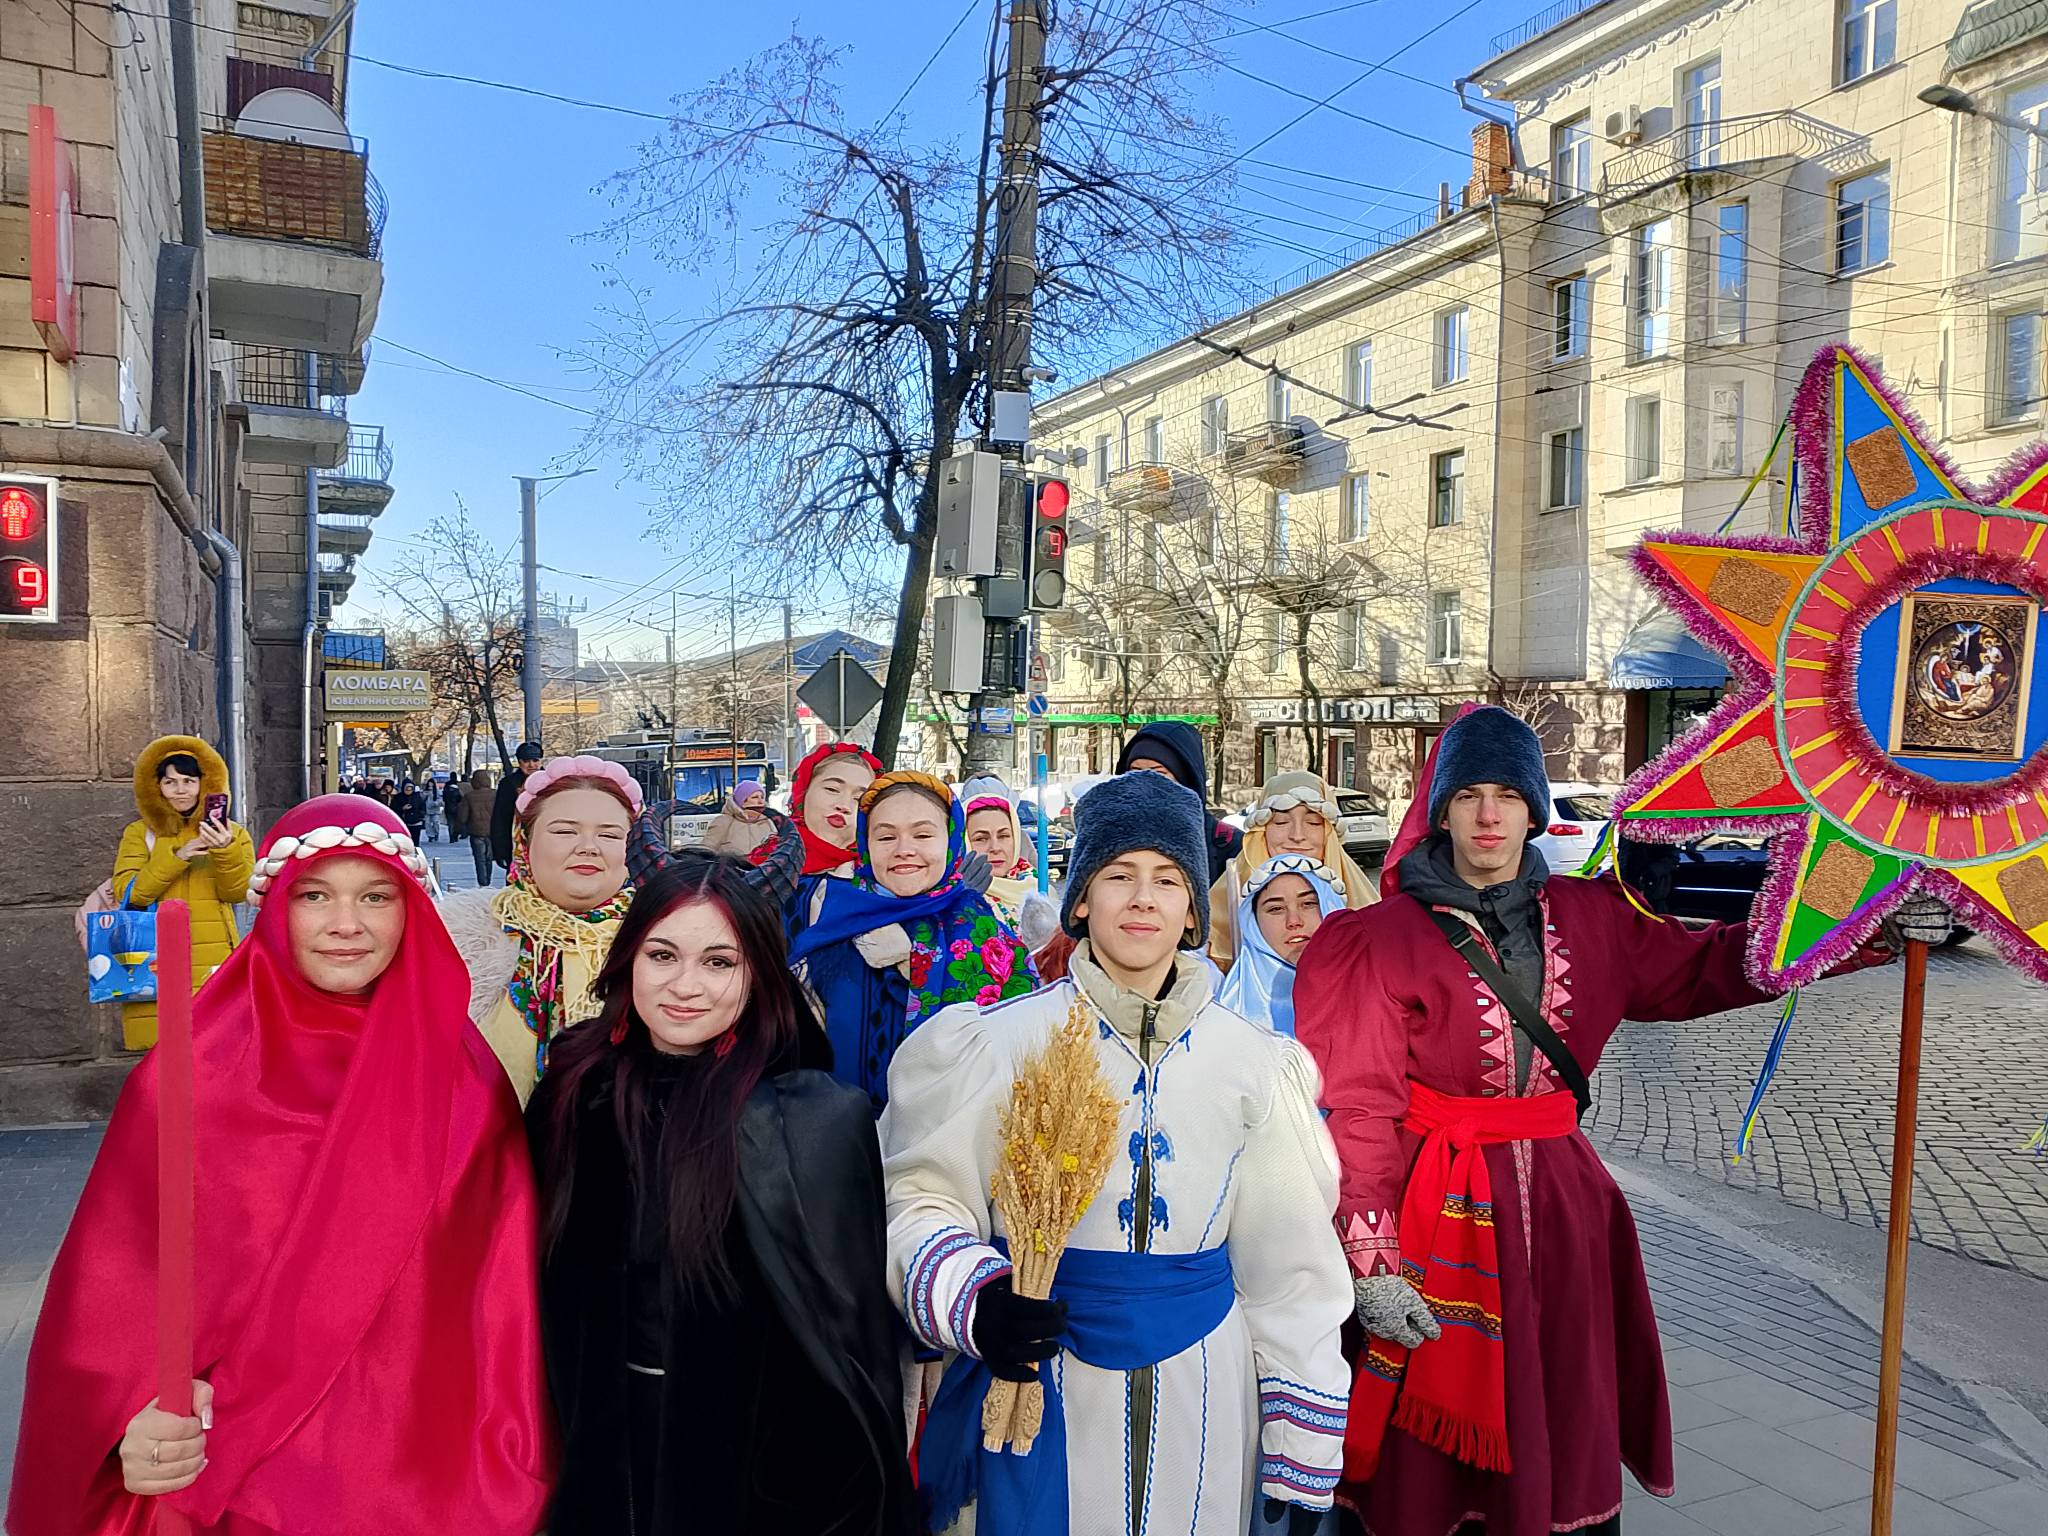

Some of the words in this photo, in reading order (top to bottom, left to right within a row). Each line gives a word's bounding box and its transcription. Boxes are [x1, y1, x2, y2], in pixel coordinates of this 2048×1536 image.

[17, 567, 43, 602] 9
[331, 676, 427, 692] ЛОМБАРД
[1632, 677, 1674, 688] GARDEN
[391, 697, 428, 705] САЛОН
